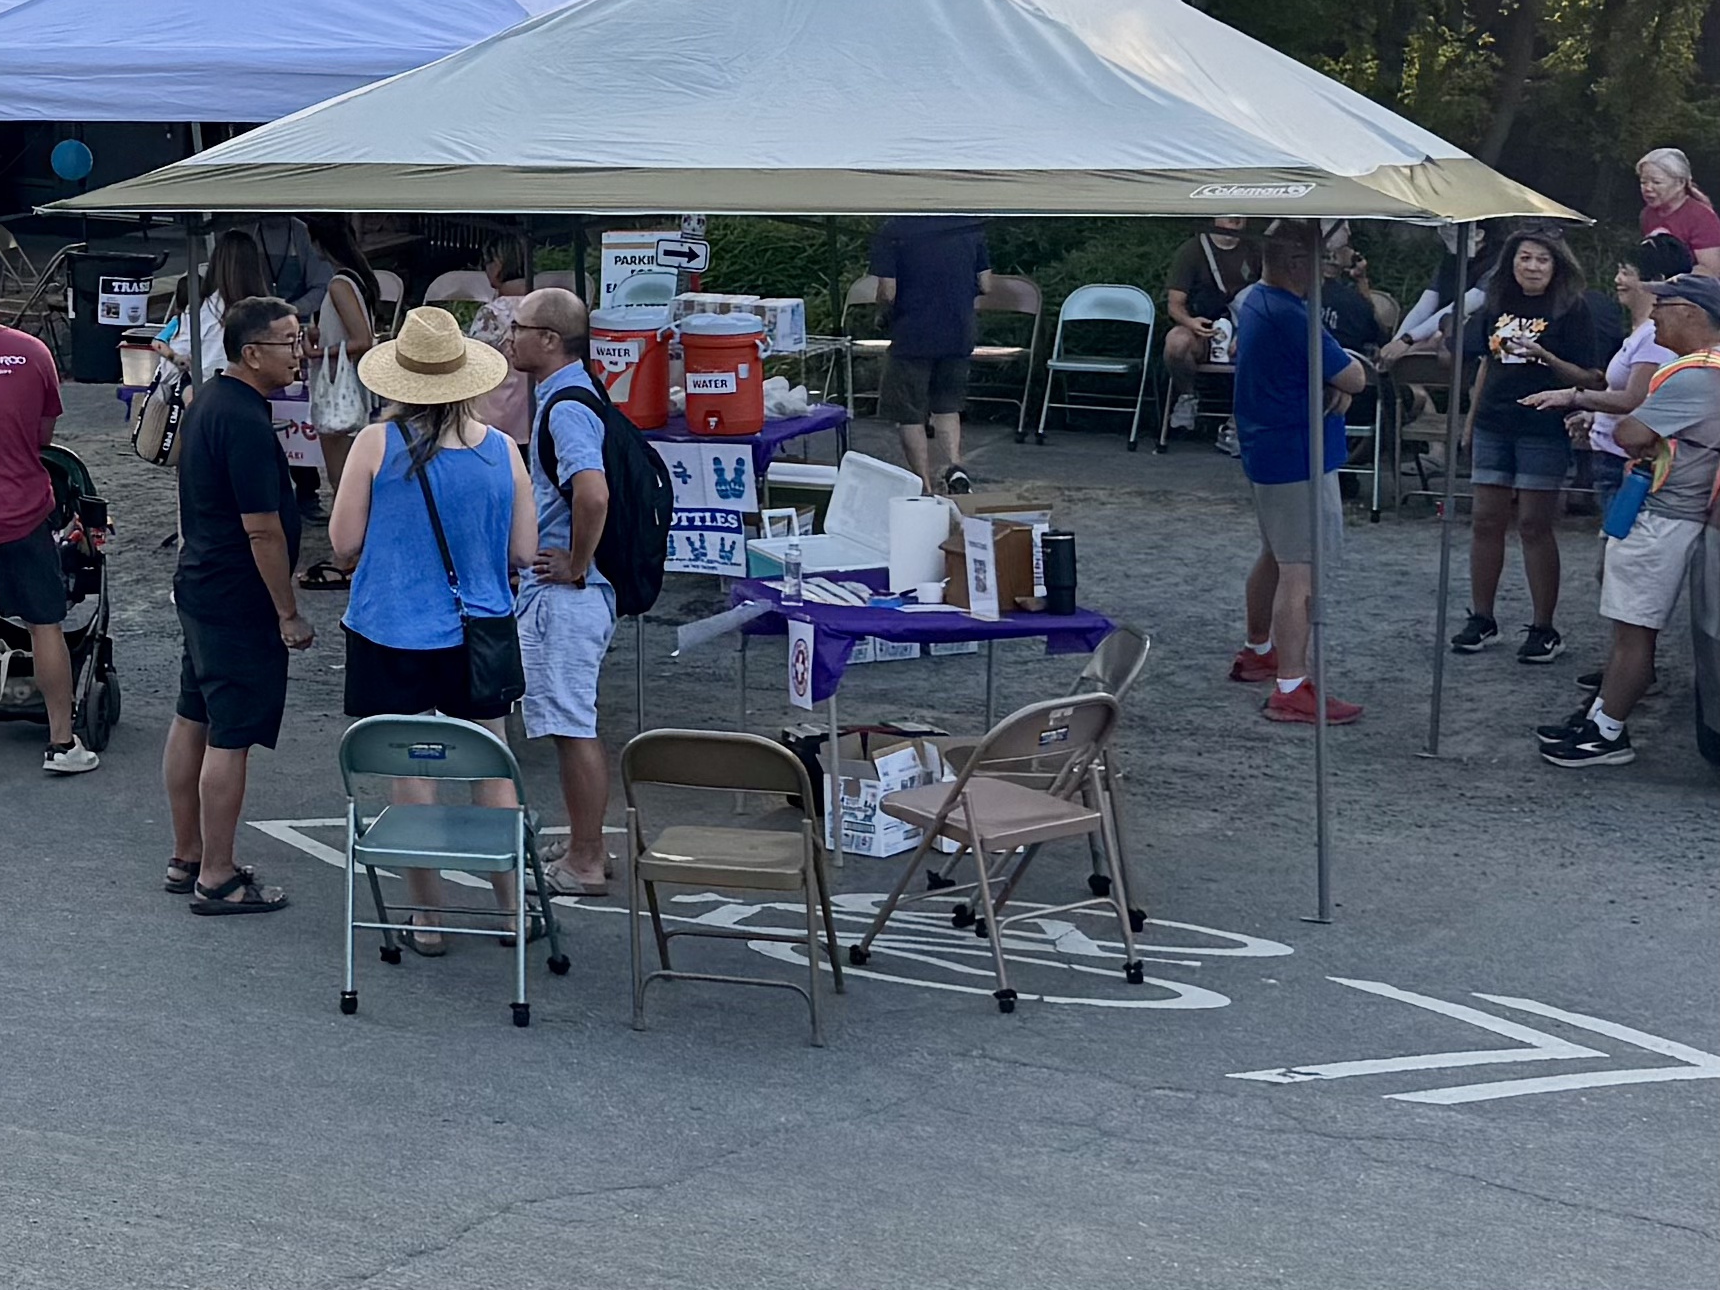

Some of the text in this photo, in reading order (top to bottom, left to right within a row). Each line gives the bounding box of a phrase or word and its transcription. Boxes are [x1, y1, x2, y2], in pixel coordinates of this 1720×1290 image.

[1202, 185, 1285, 196] Coleman
[614, 255, 655, 266] PARKI
[596, 346, 630, 357] WATER
[0, 356, 26, 366] ROO
[692, 379, 727, 388] WATER
[671, 511, 738, 528] OTTLES
